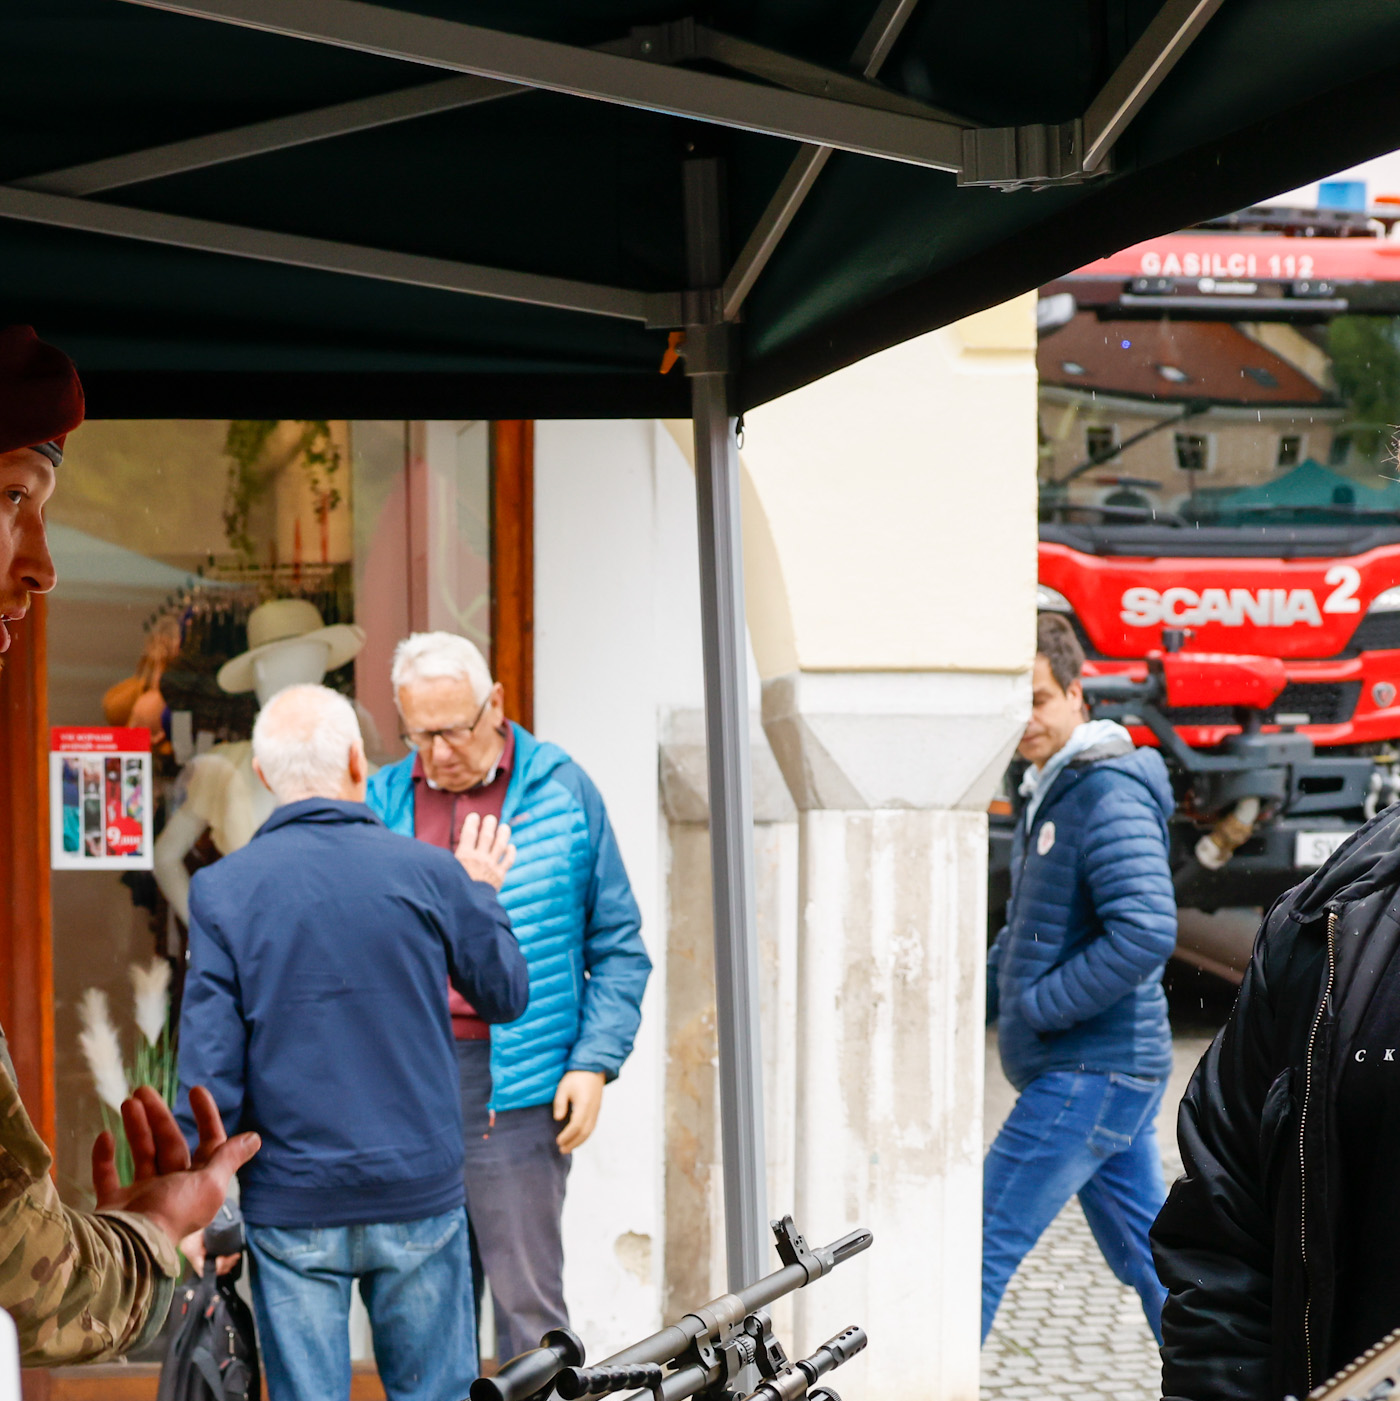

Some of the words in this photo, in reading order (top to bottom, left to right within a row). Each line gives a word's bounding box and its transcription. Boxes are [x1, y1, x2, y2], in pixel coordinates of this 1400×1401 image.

[1140, 252, 1257, 278] GASILCI
[1268, 254, 1314, 279] 112
[1119, 587, 1324, 627] SCANIA
[1322, 565, 1362, 614] 2
